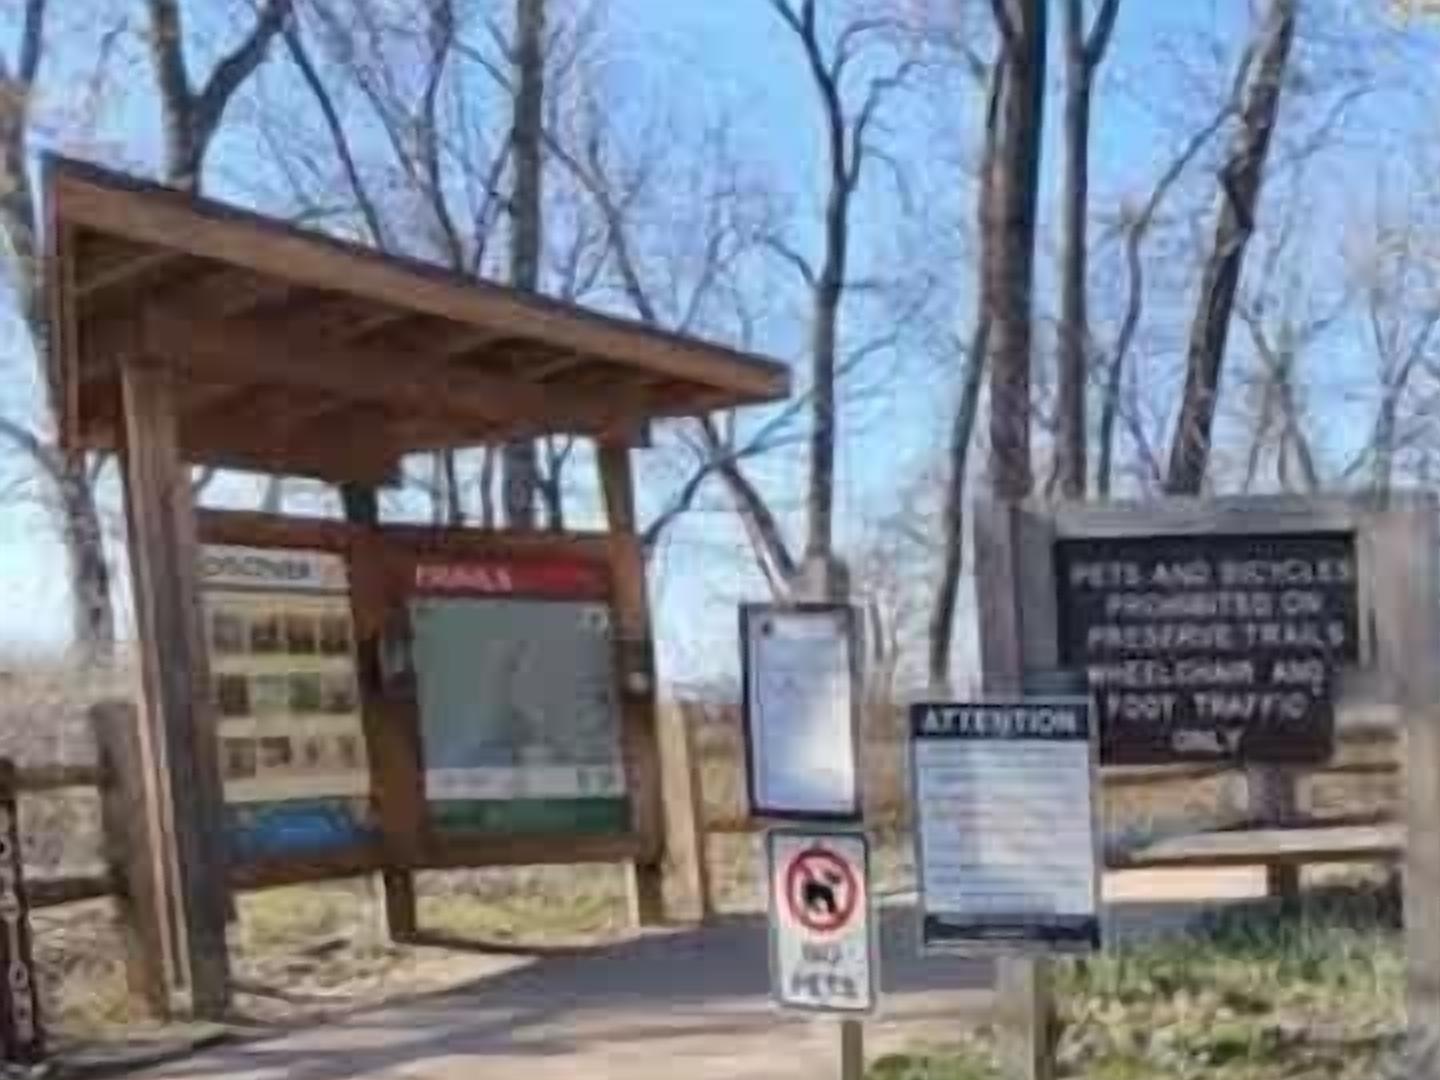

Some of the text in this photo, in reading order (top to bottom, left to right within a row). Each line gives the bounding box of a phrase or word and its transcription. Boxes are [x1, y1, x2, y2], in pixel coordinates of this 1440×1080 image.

[1069, 560, 1350, 588] PETS AND BICYCLES
[1105, 591, 1322, 618] PROHIBITED ON
[1088, 622, 1344, 648] PRESERVE TRAILS
[1106, 692, 1308, 720] FOOT TRAFFIC
[924, 707, 1077, 734] ATTENTION
[791, 972, 858, 998] PETS
